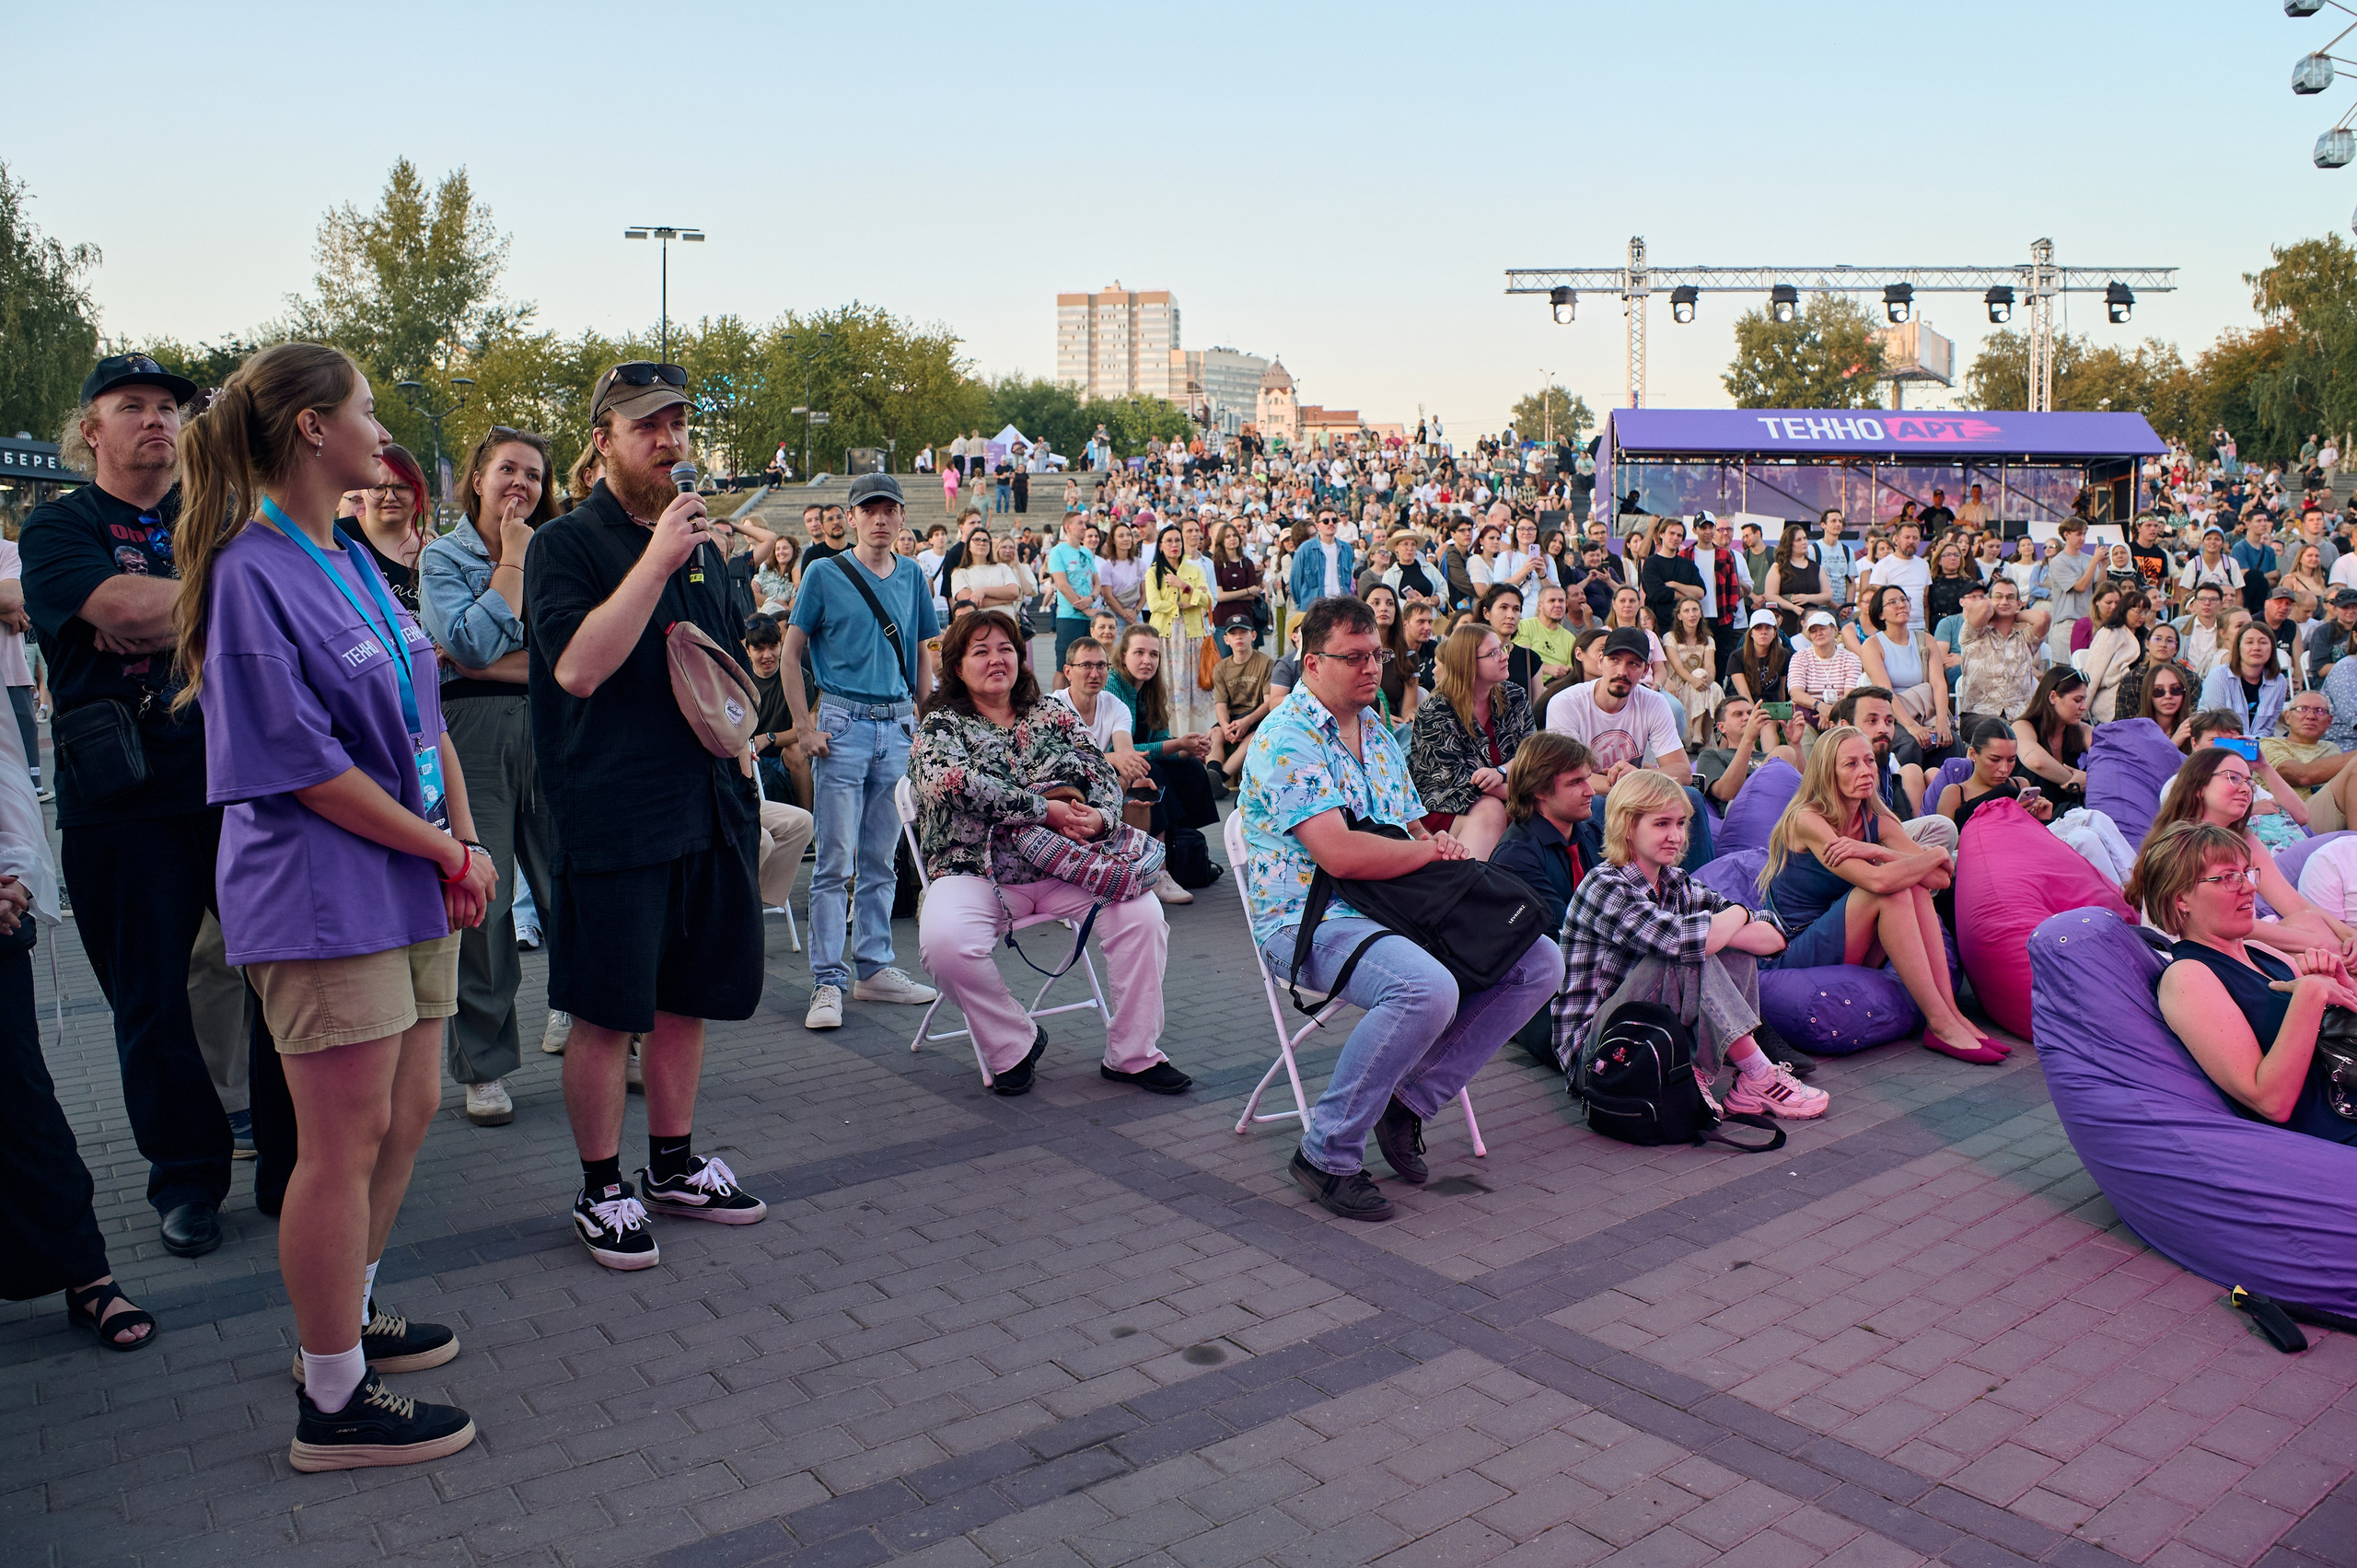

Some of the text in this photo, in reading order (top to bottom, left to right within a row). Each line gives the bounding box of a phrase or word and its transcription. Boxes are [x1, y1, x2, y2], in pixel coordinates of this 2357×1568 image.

[1757, 417, 1968, 440] ТЕХНО АРТ
[430, 818, 446, 828] НТЕР
